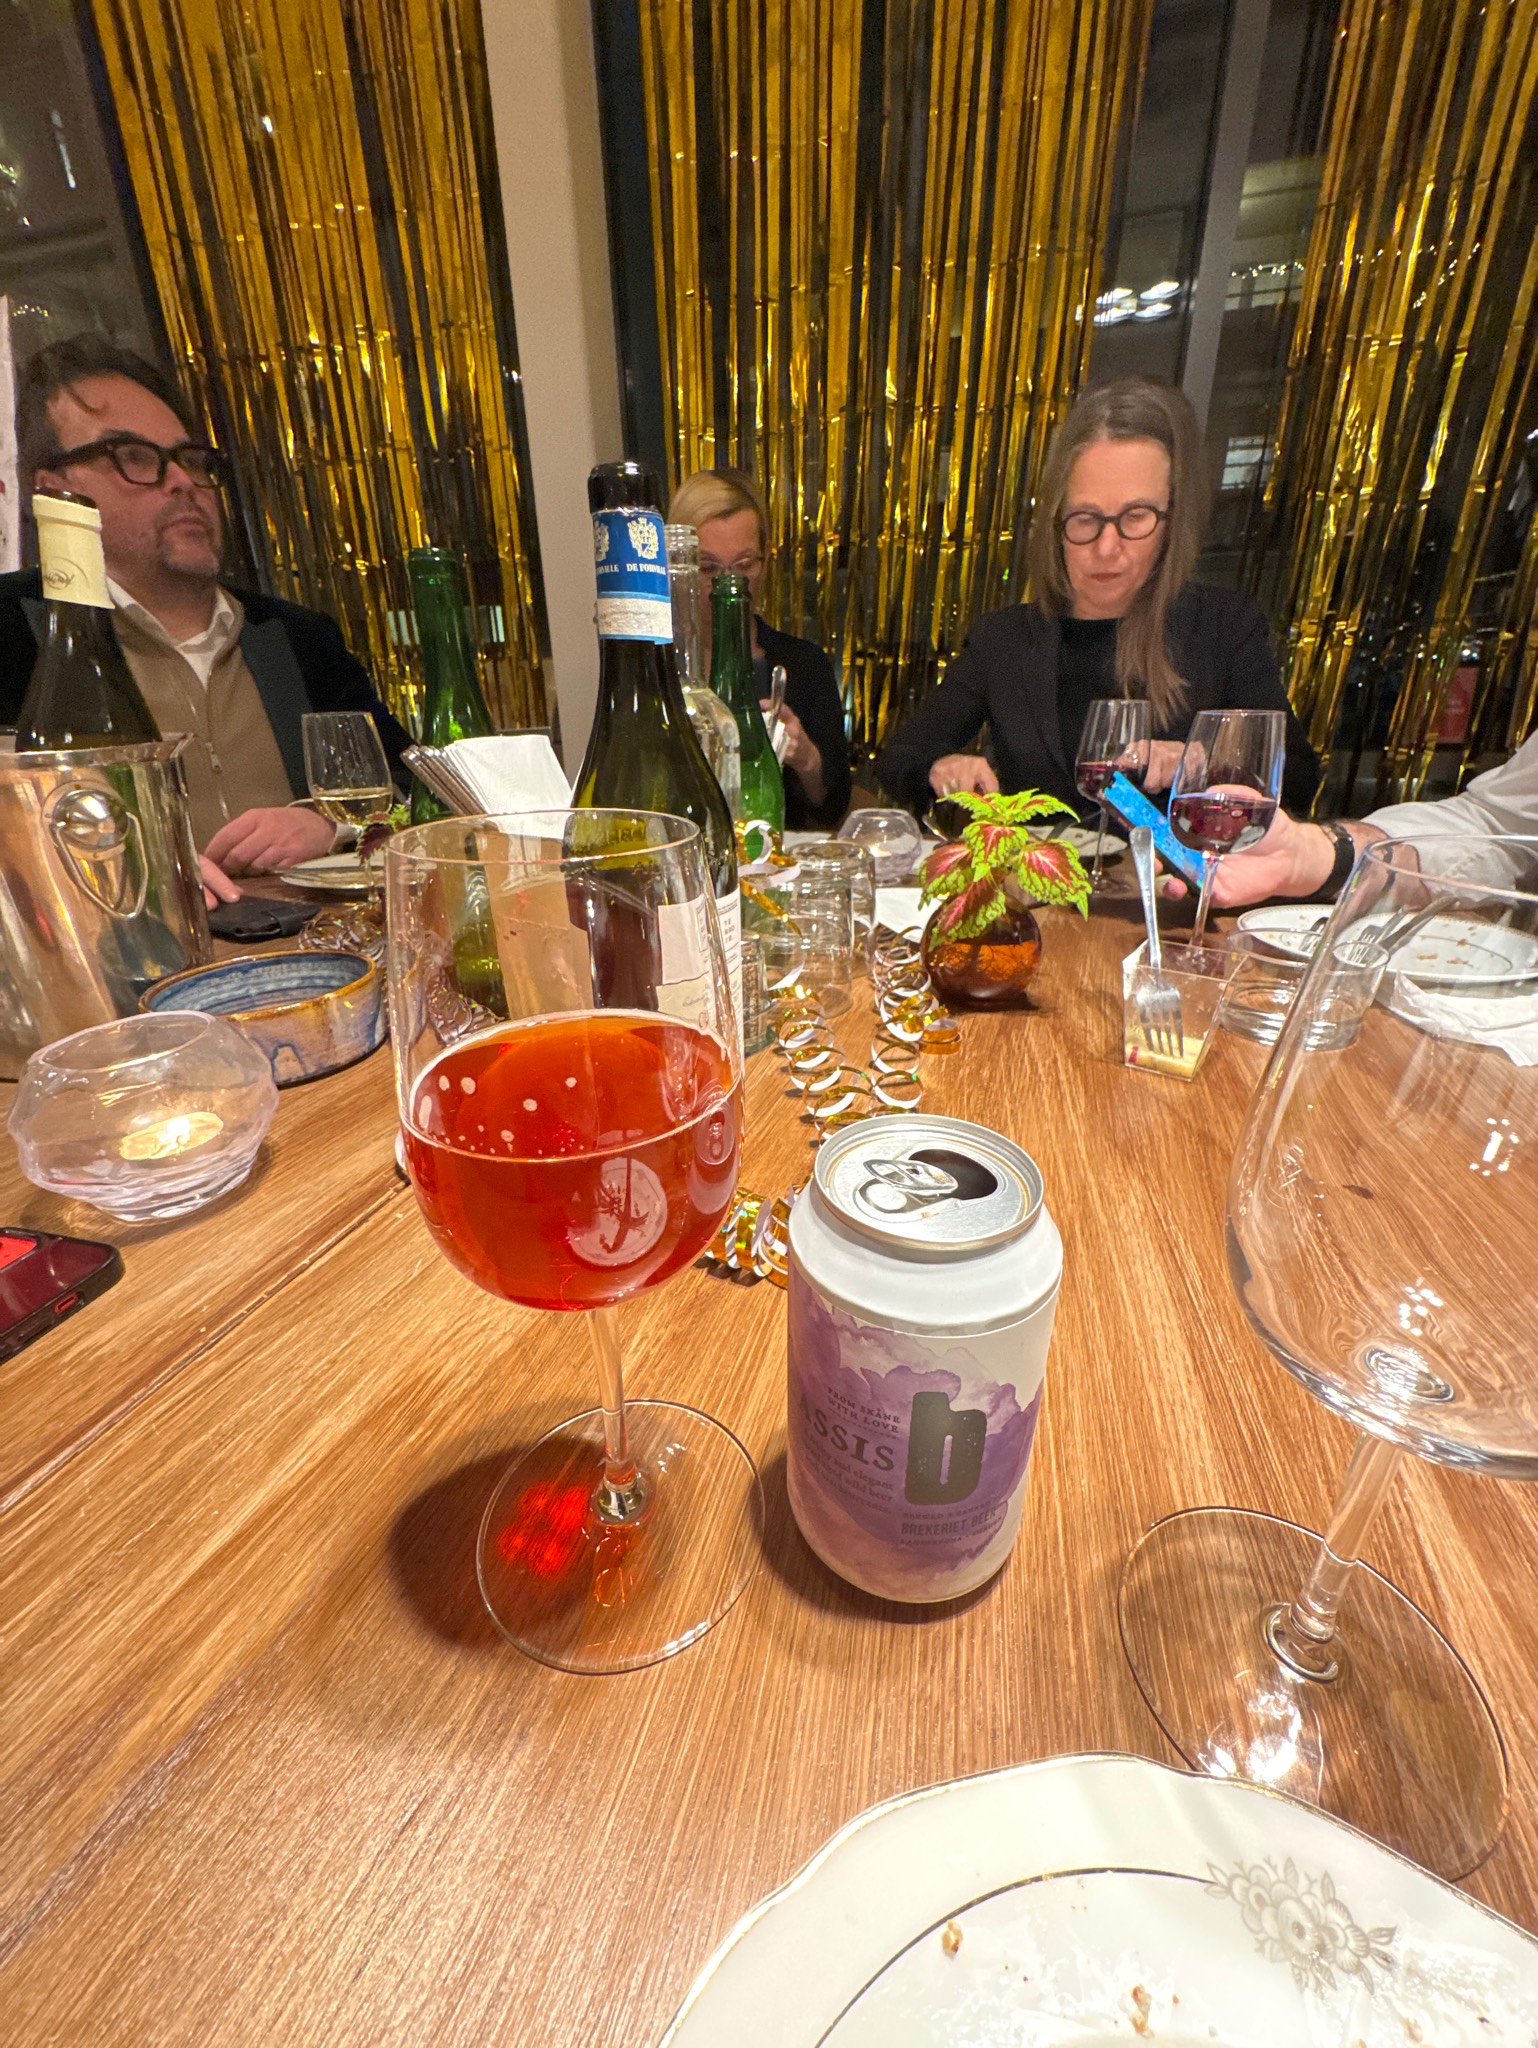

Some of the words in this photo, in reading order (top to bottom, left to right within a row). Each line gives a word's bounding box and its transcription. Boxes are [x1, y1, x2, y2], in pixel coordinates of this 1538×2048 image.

[626, 563, 639, 572] DE
[827, 1394, 858, 1420] WITH
[863, 1416, 898, 1433] LOVE
[828, 1386, 856, 1409] FROM
[859, 1401, 900, 1424] SKÅNE
[833, 1456, 851, 1474] and
[853, 1467, 893, 1491] elegant
[845, 1474, 866, 1493] wild
[868, 1487, 893, 1502] beer
[901, 1519, 967, 1536] BREKERIET
[971, 1506, 996, 1528] BEER
